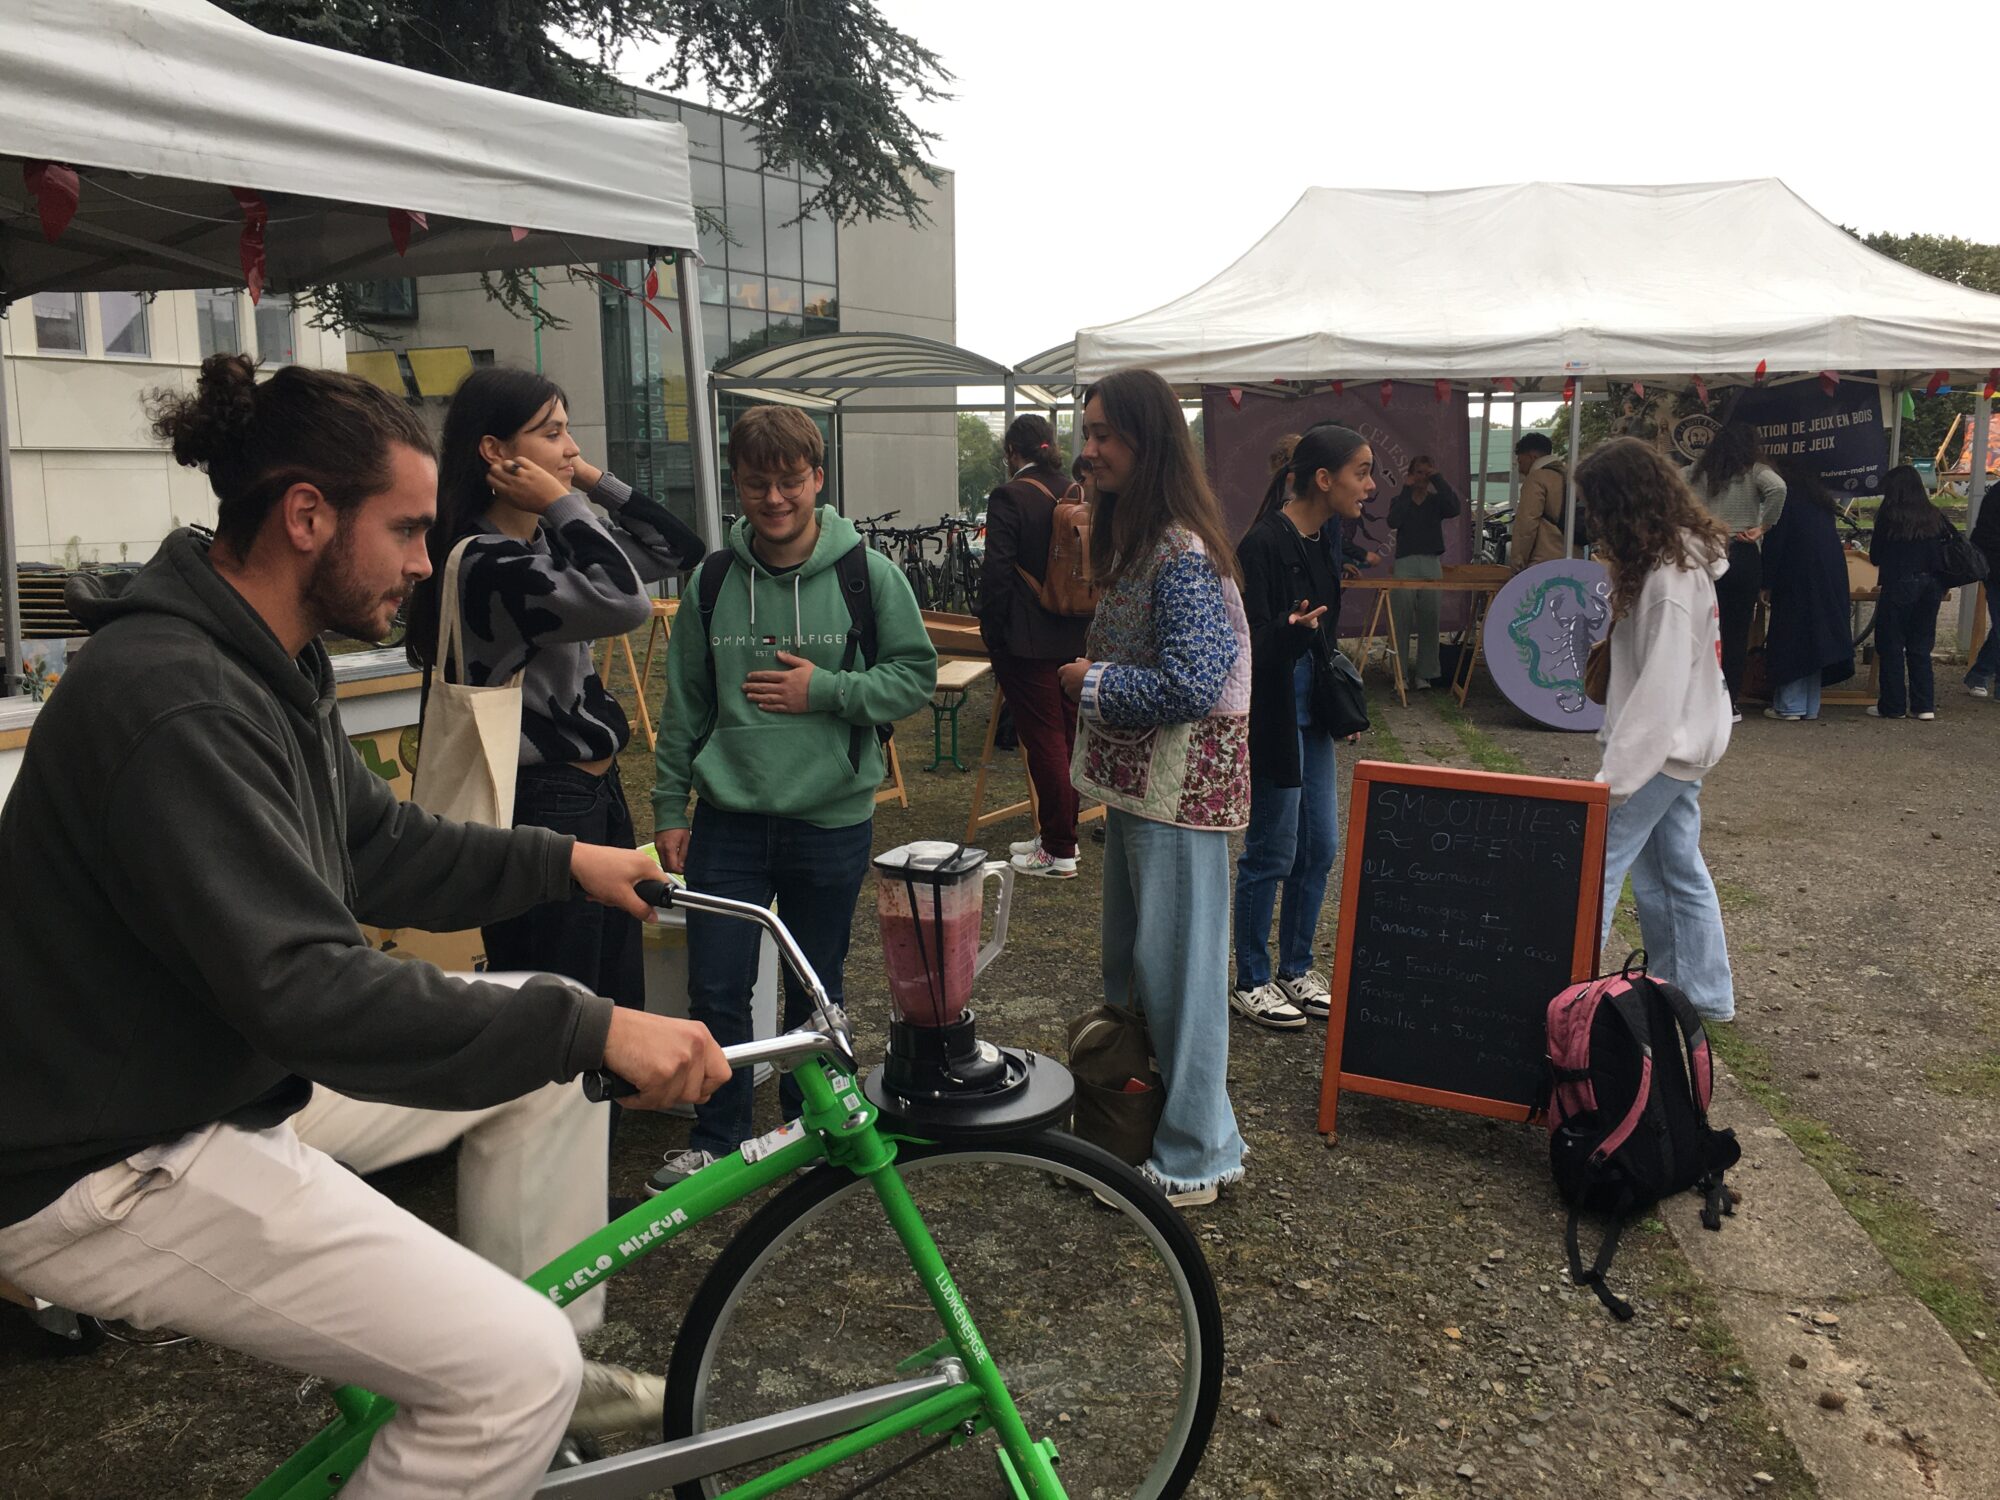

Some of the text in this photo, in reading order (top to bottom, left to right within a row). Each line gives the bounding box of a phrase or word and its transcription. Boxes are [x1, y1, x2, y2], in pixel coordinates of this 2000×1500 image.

[1791, 421, 1806, 435] DE
[1808, 415, 1835, 433] JEUX
[1836, 413, 1850, 428] EN
[1851, 409, 1873, 425] BOIS
[1792, 440, 1806, 454] DE
[1809, 435, 1836, 452] JEUX
[1865, 464, 1878, 473] sur
[712, 635, 757, 647] OMMY
[1430, 831, 1549, 864] OFFERT
[1407, 862, 1494, 888] Gourmand
[1359, 1007, 1417, 1031] Basilic
[548, 1284, 564, 1302] E
